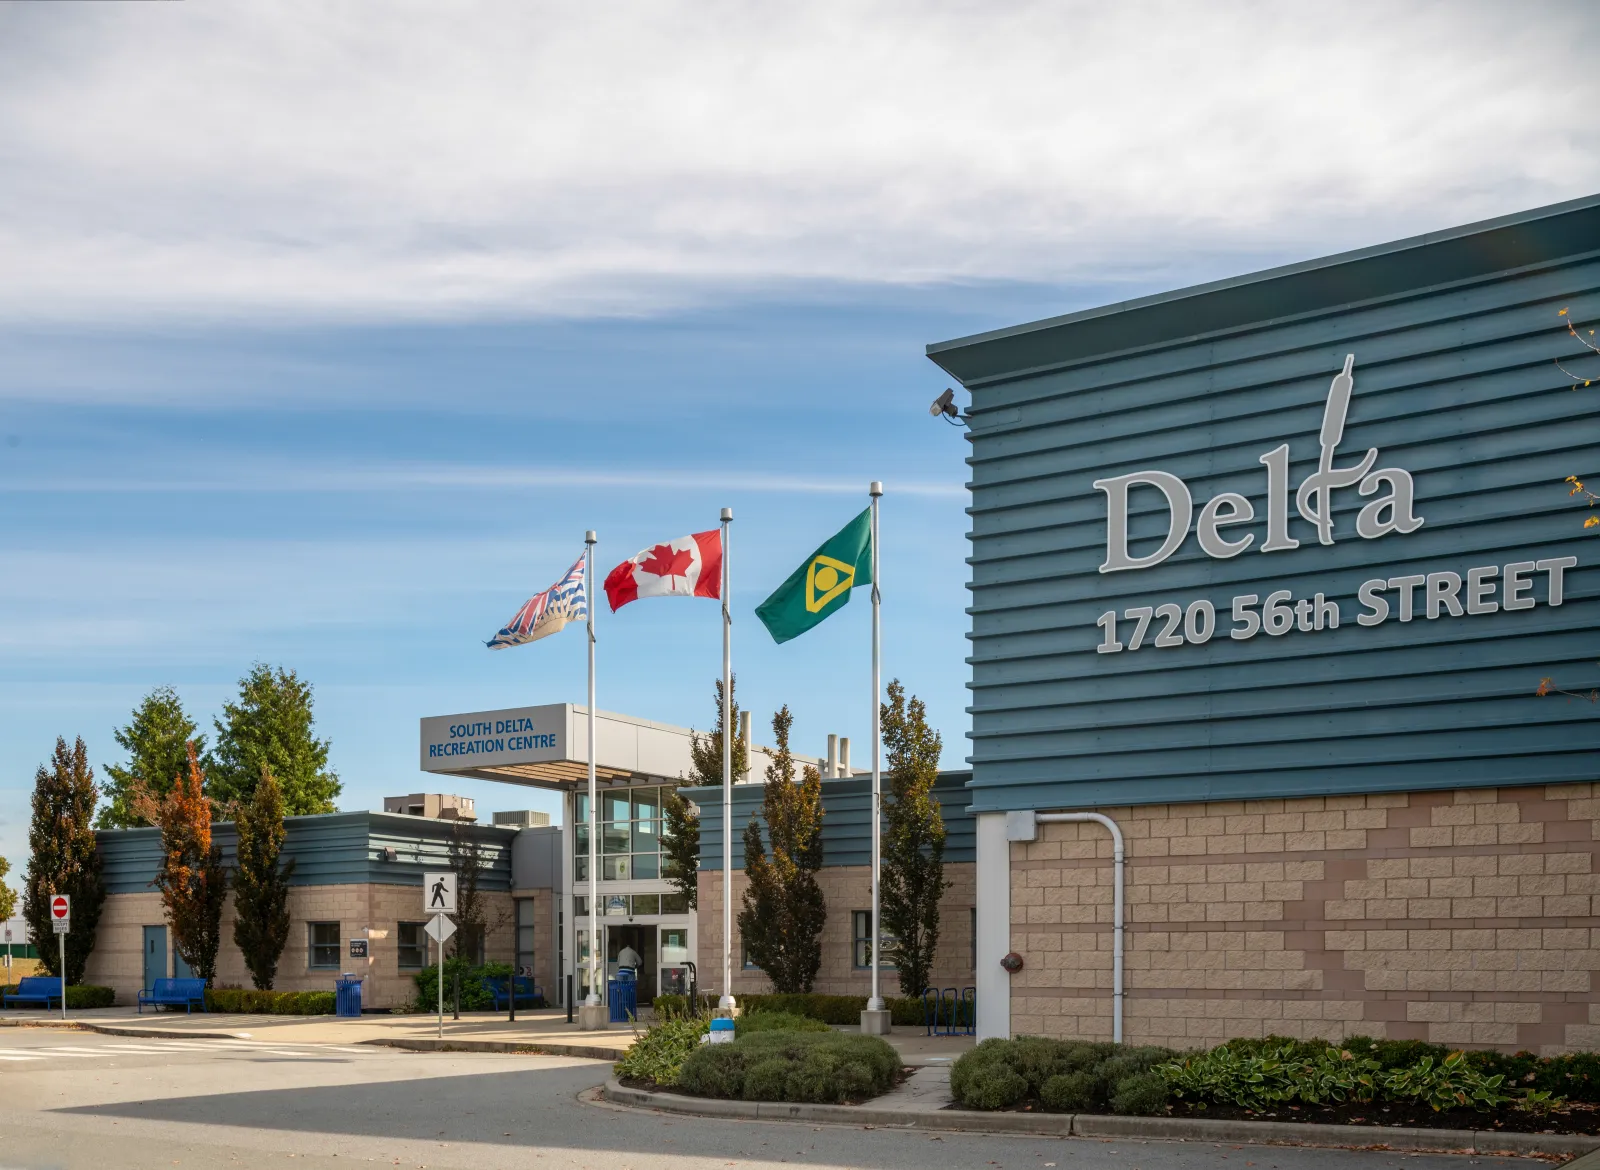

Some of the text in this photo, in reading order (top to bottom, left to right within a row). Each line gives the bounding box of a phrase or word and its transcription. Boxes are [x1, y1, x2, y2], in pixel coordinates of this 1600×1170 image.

[1093, 354, 1425, 573] Delta
[1097, 556, 1578, 654] 1720 56th STREET
[429, 733, 556, 758] RECREATION CENTRE
[449, 717, 534, 739] SOUTH DELTA
